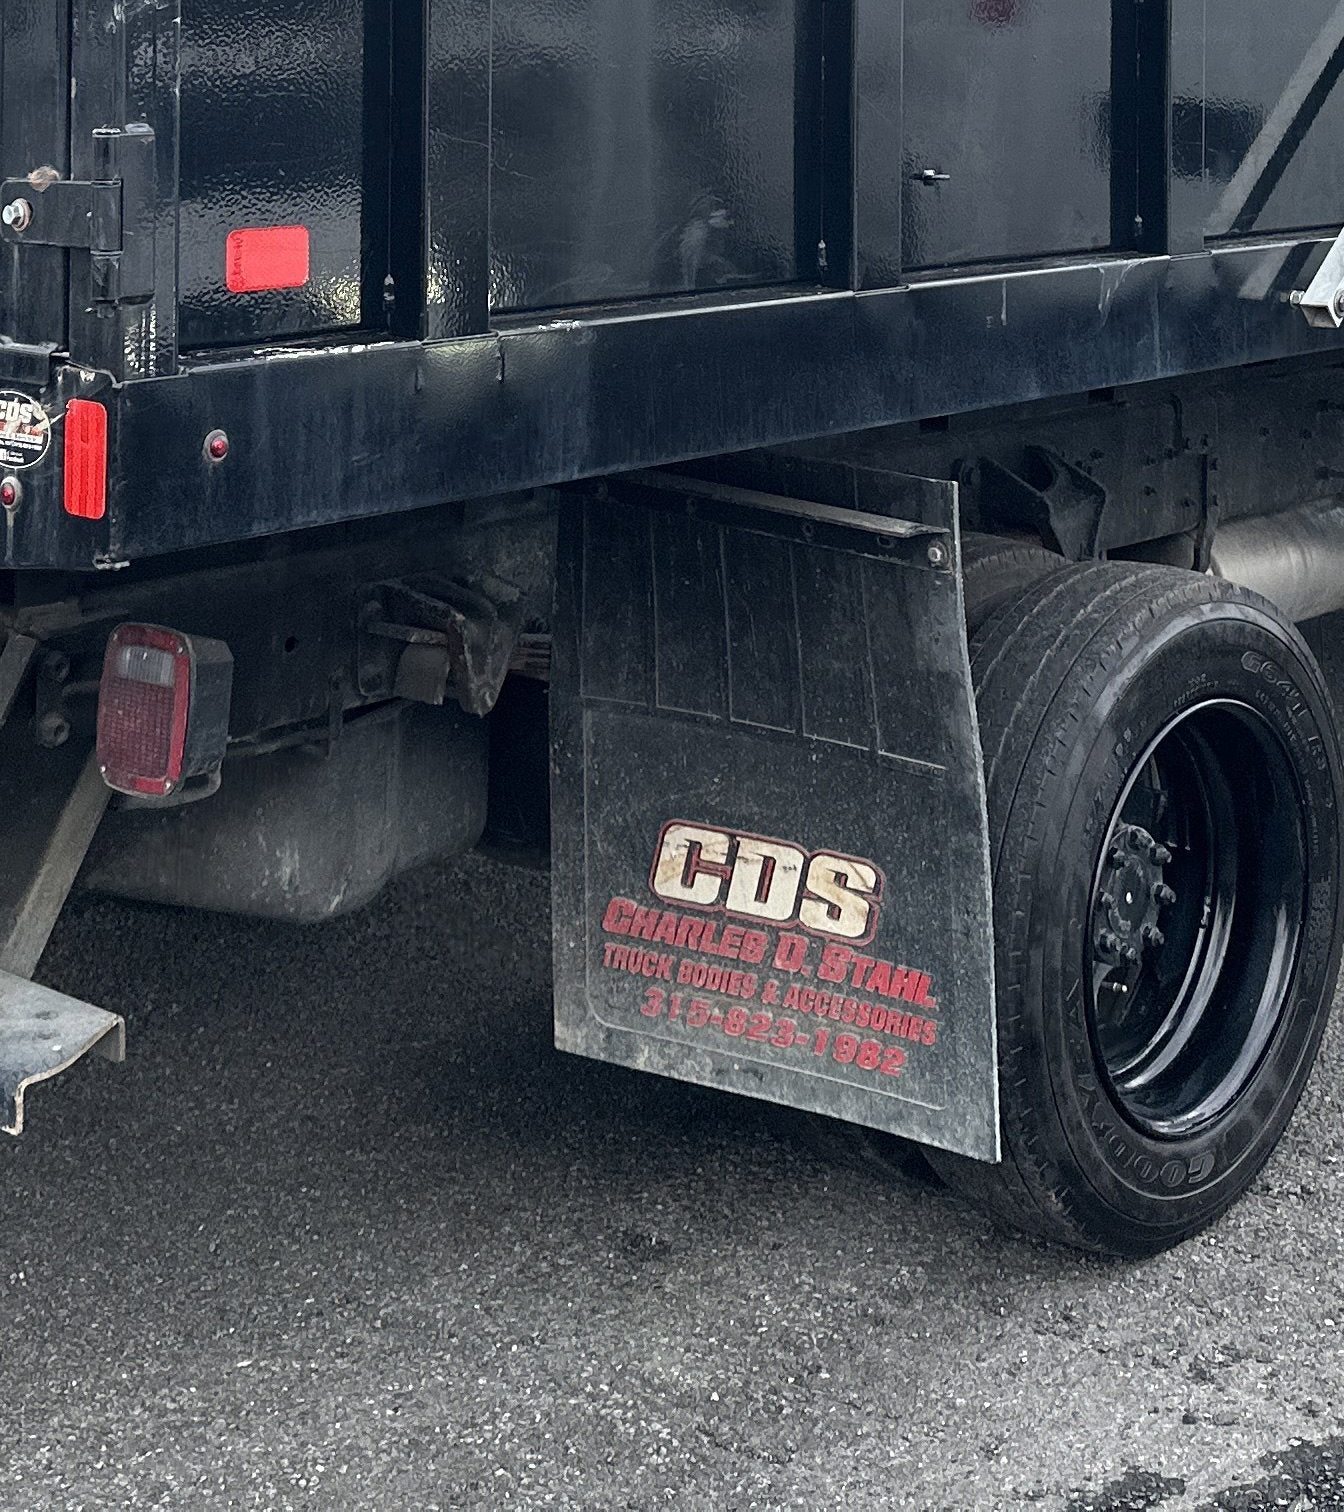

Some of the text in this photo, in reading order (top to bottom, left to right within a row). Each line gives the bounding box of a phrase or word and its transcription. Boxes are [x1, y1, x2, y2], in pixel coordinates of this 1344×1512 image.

[651, 821, 882, 943] CDS
[602, 896, 939, 1009] CHARLES D. STAHL
[602, 941, 938, 1047] TRUCK BODIES & ACCESSORIES
[640, 986, 908, 1078] 315-823-1982
